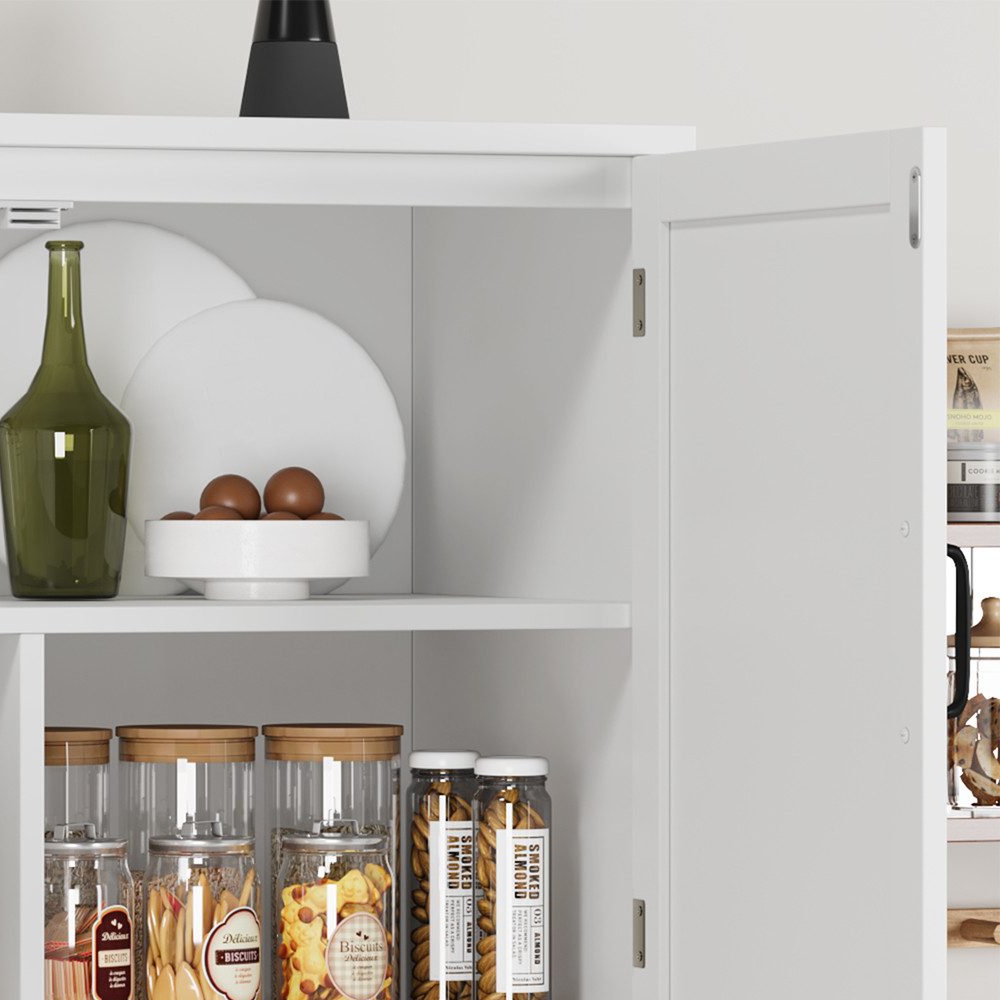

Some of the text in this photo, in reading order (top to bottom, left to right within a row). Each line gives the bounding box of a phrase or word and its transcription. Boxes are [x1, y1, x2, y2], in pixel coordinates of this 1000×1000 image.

[968, 354, 989, 364] CUP
[447, 835, 460, 890] ALMOND
[461, 835, 472, 890] SMOKED
[514, 844, 528, 899] ALMOND
[529, 844, 540, 900] SMOKED
[104, 952, 128, 964] BISCUITS
[224, 950, 258, 963] BISCUITS
[340, 940, 384, 952] Biscuits
